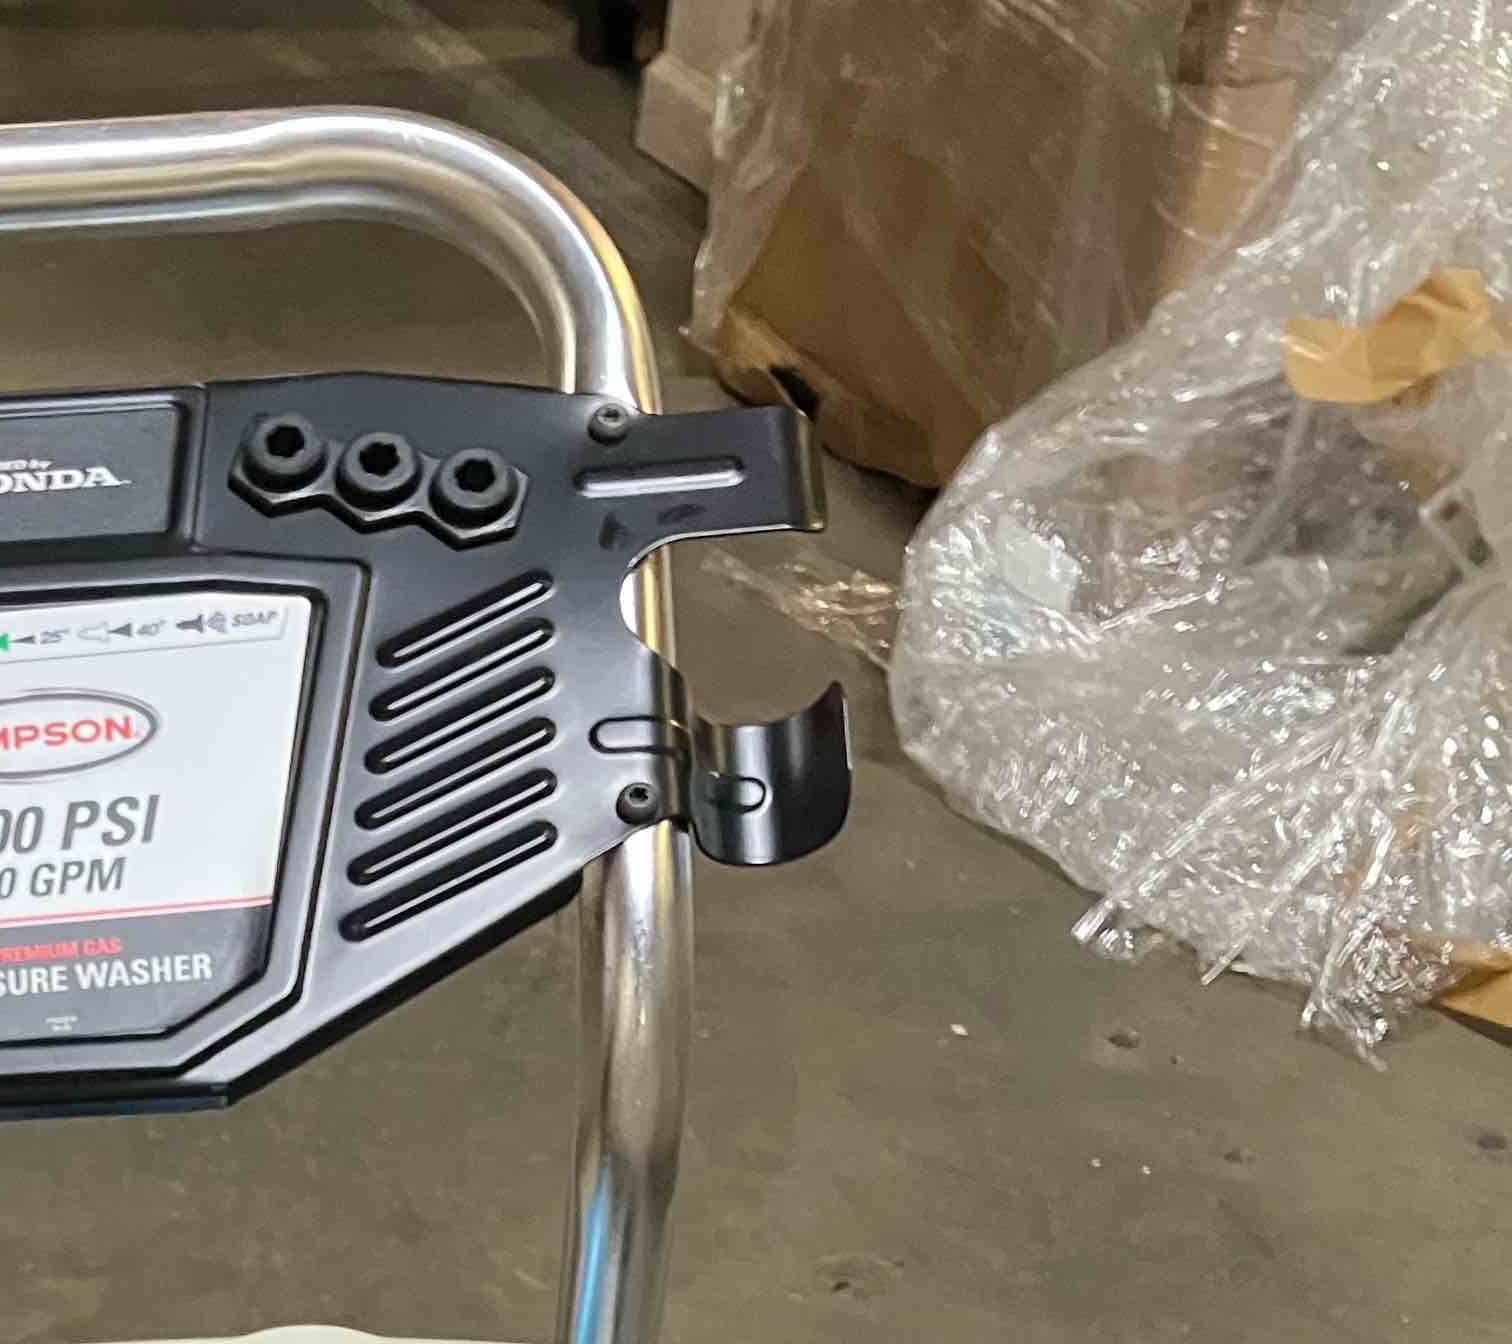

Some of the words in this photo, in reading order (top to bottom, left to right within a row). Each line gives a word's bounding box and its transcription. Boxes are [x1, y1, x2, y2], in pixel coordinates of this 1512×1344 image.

[61, 794, 161, 851] PSI
[29, 857, 127, 897] GPM
[83, 938, 121, 955] GAS
[73, 953, 213, 991] WASHER
